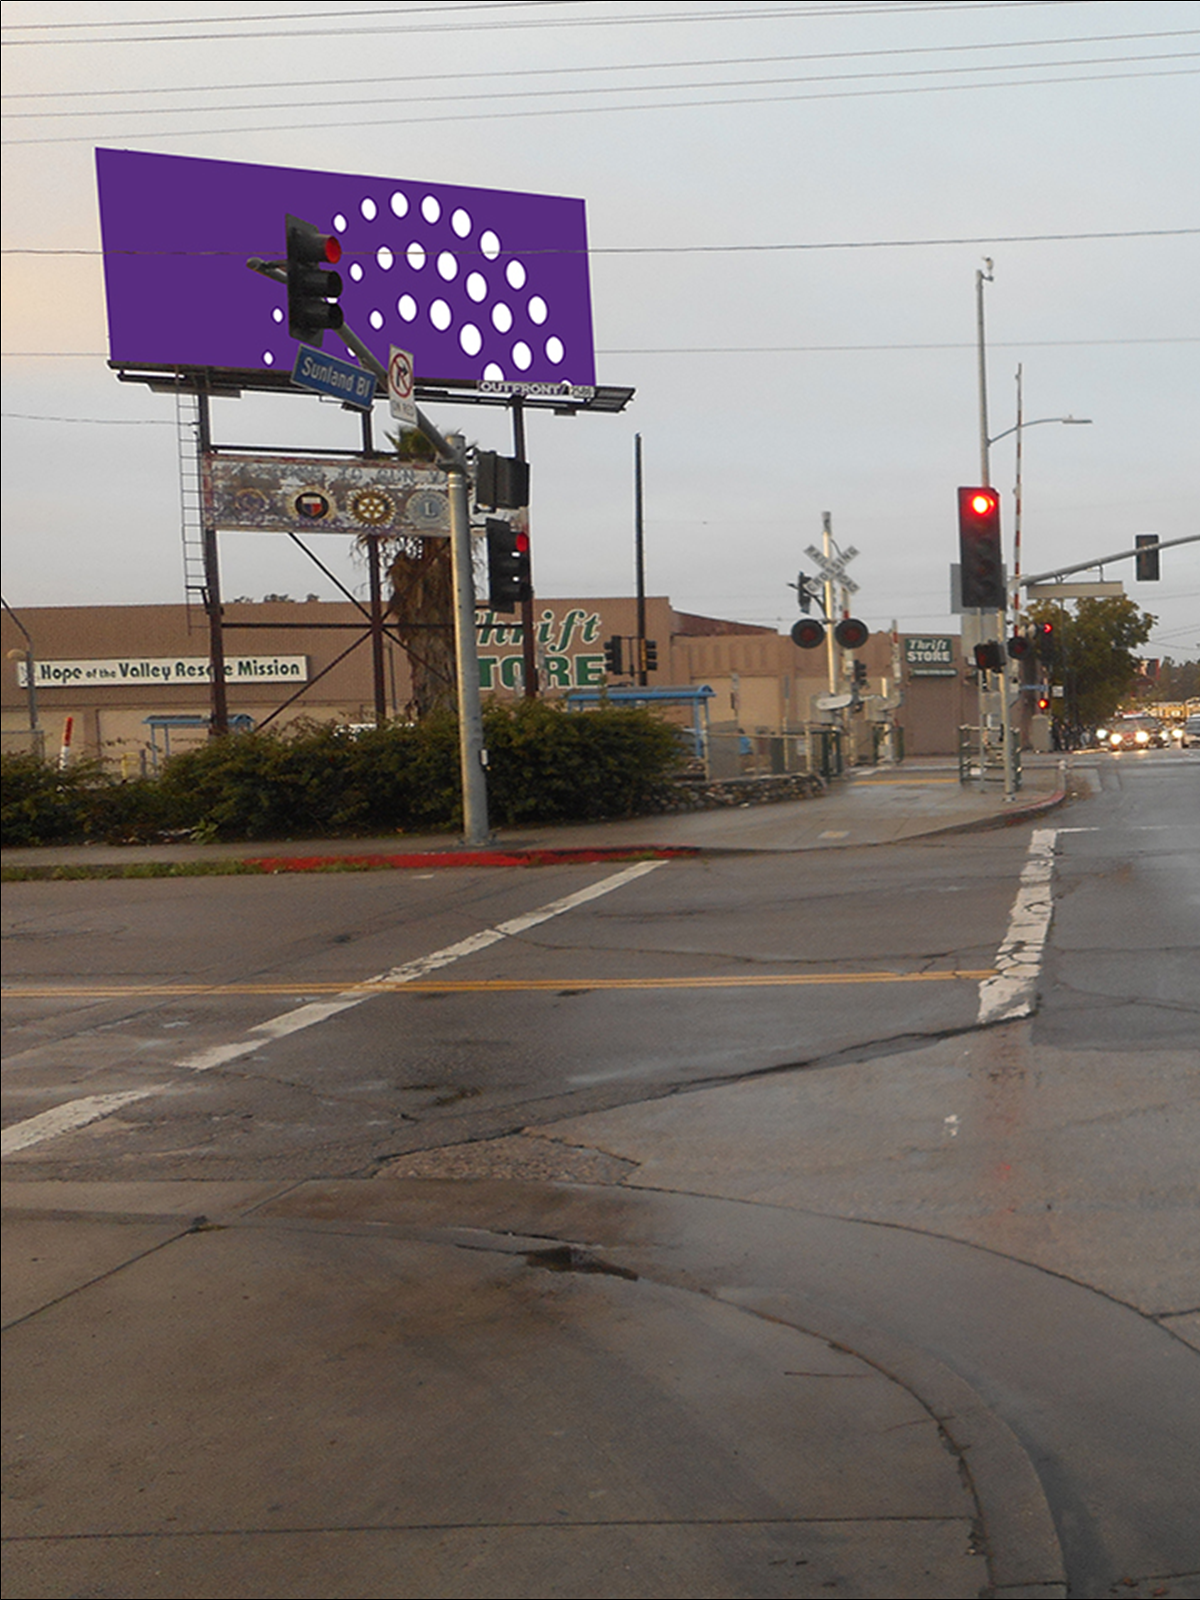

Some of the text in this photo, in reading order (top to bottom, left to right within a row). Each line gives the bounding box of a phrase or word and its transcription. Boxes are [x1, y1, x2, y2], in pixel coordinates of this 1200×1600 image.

[301, 357, 371, 398] Sunland Bl
[474, 609, 601, 653] hrift
[908, 639, 947, 651] Thrift
[41, 659, 300, 683] Hope of the Valley Resce Mission
[907, 650, 951, 662] STORE
[477, 653, 605, 690] TORE
